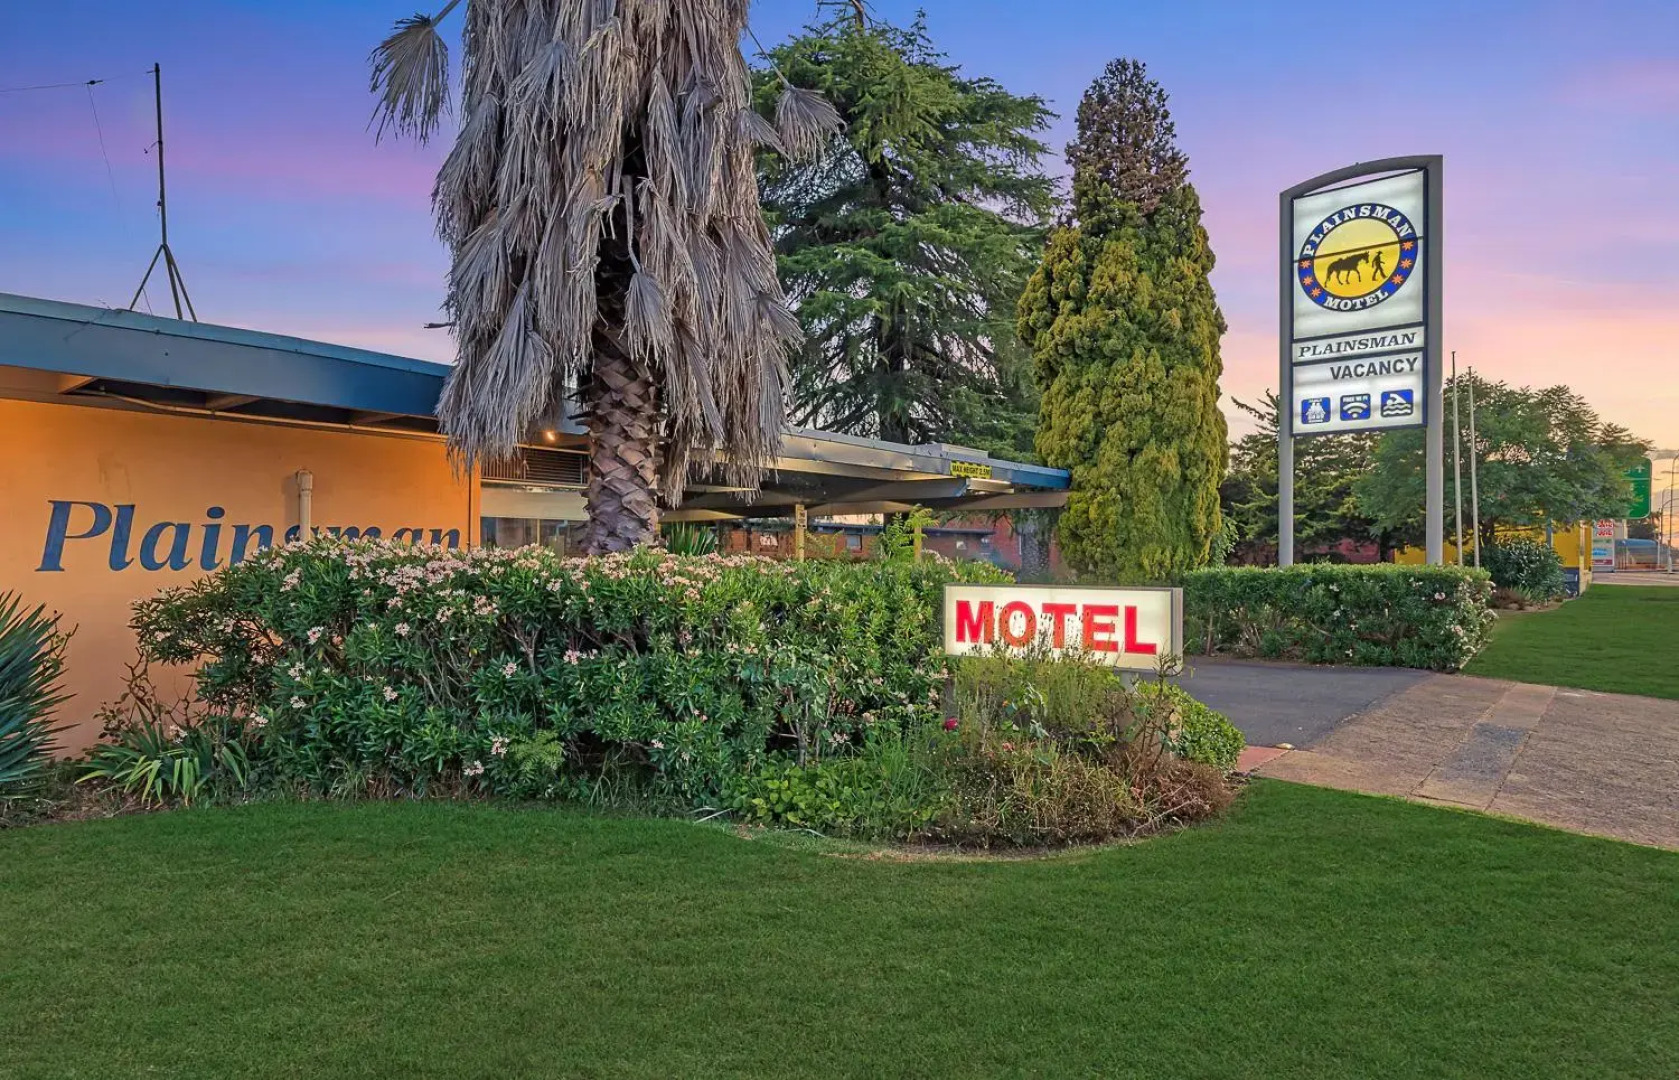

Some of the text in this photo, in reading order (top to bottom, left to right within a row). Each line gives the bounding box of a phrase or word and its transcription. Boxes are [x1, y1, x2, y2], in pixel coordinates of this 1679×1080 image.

[1303, 205, 1412, 256] PLAINSMAN
[1324, 289, 1389, 310] MOTEL
[1298, 332, 1417, 358] PLAINSMAN
[1330, 357, 1418, 380] VACANCY
[956, 600, 1157, 655] MOTEL
